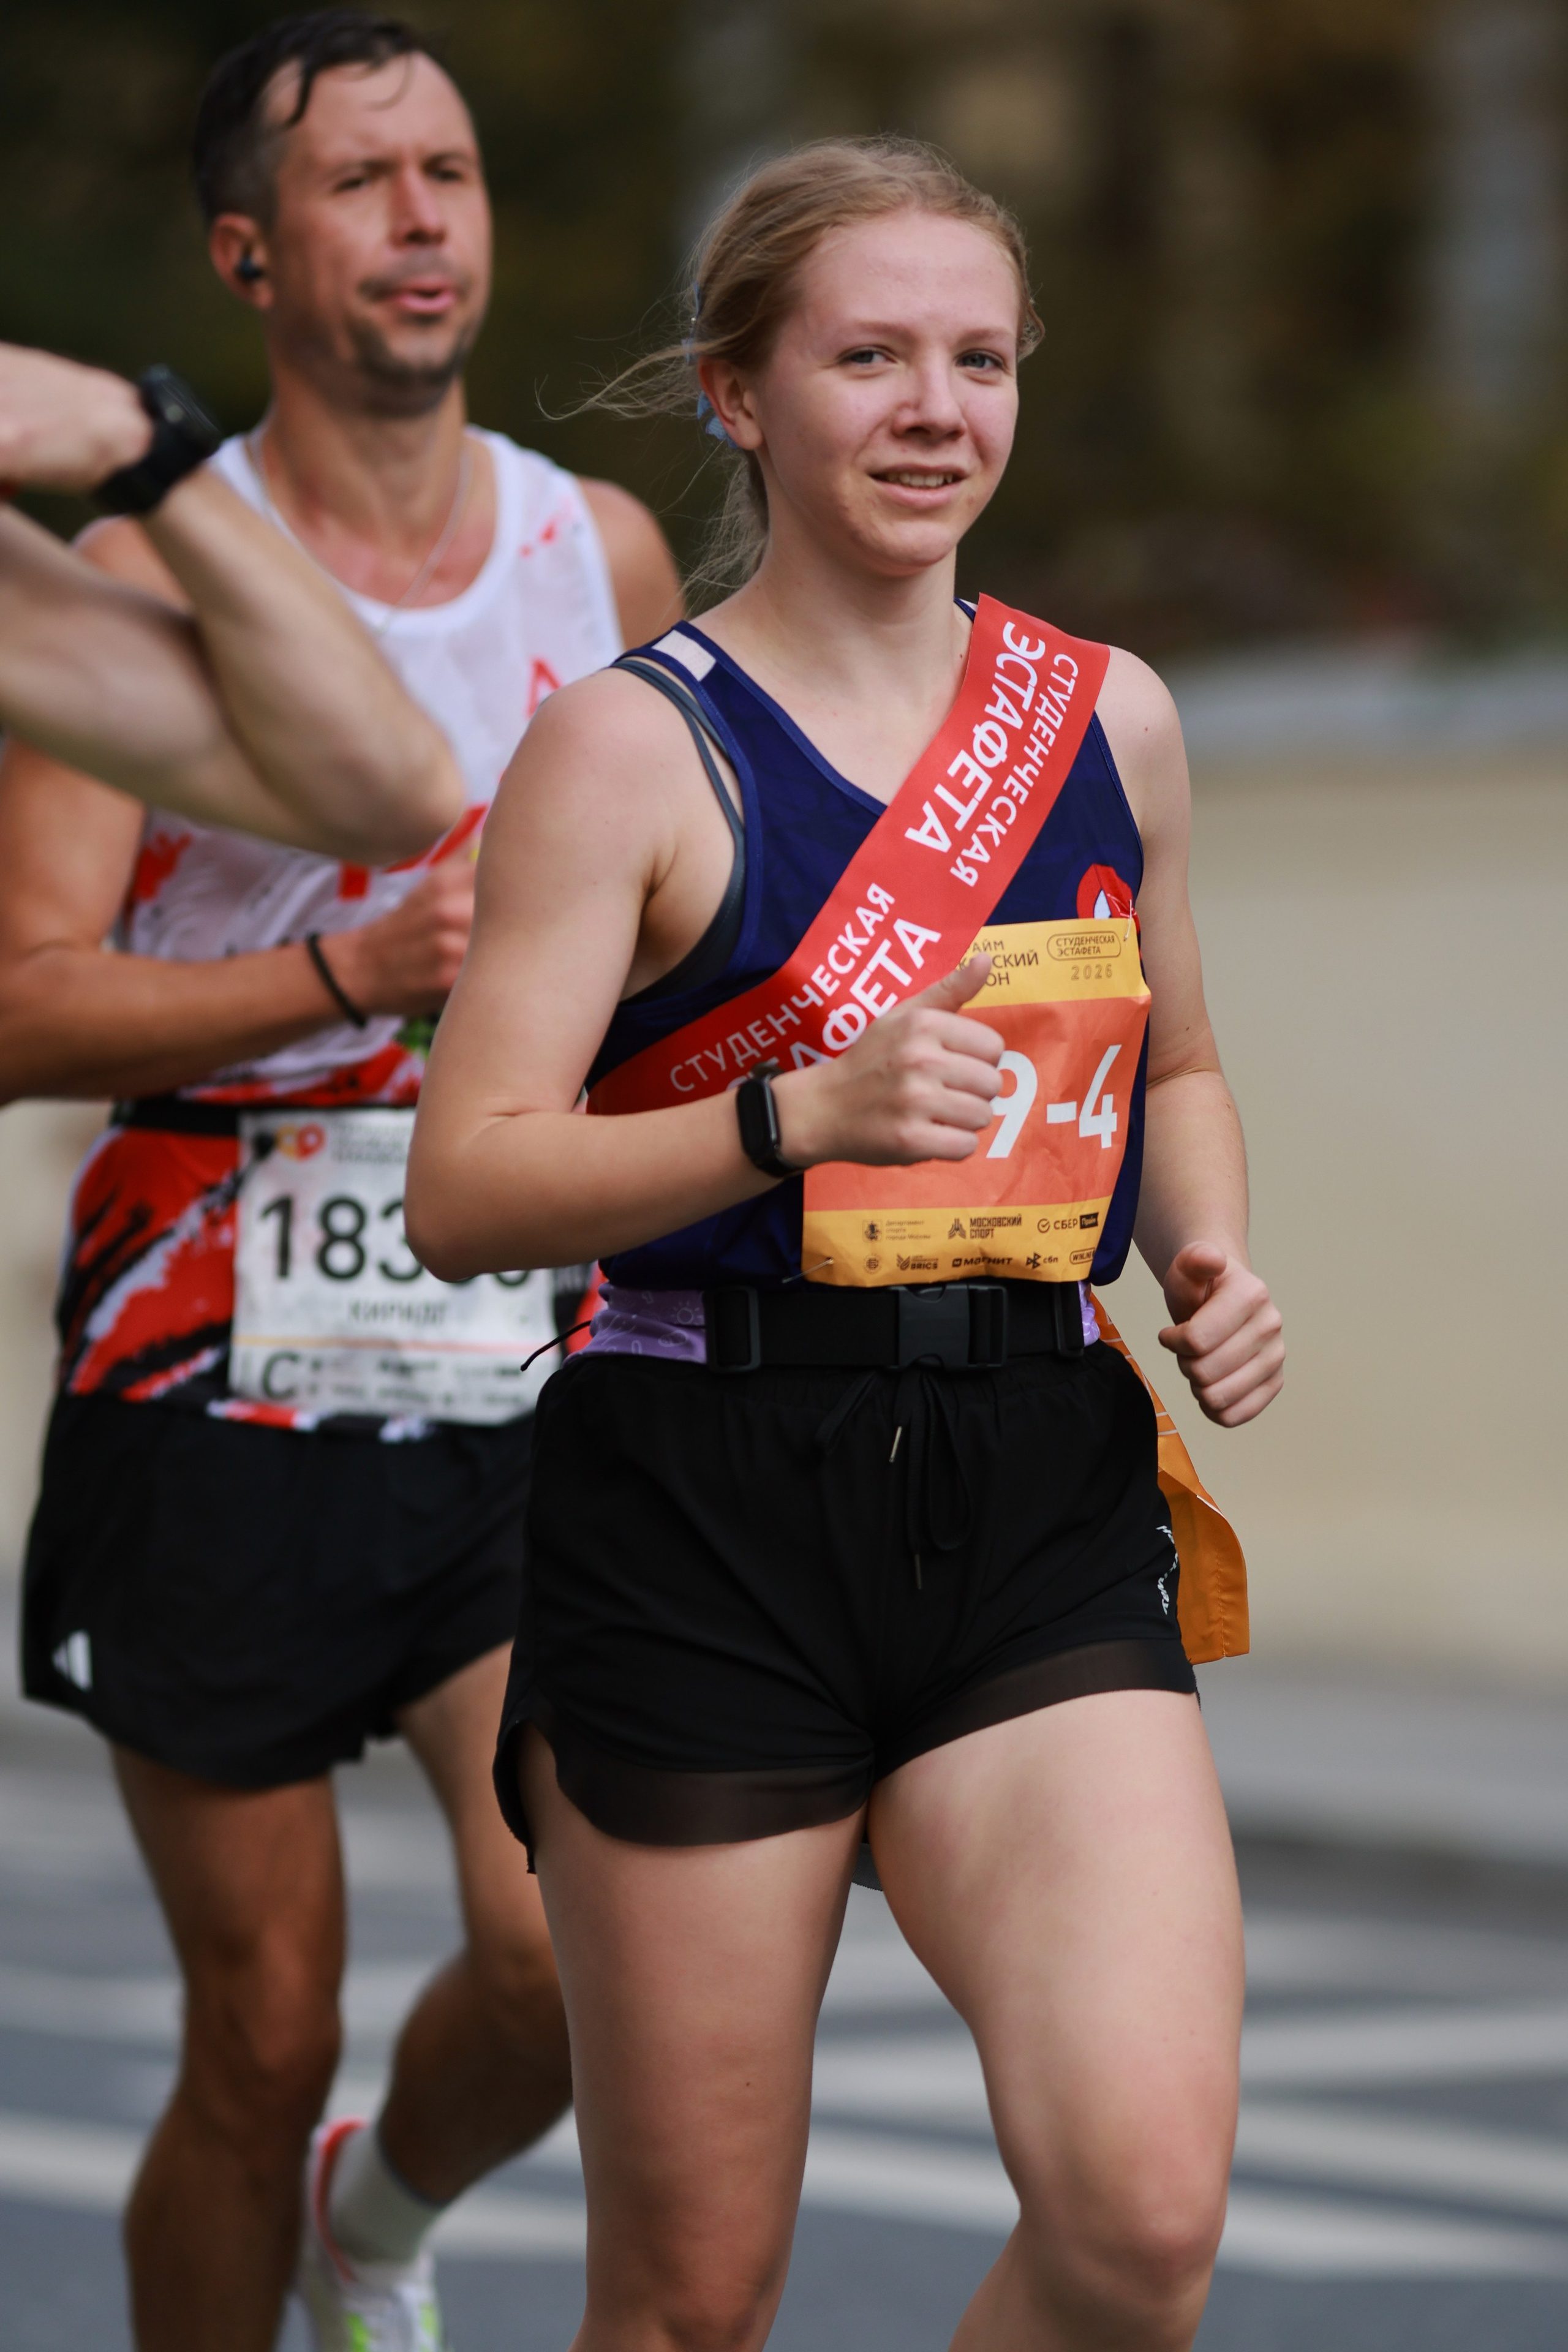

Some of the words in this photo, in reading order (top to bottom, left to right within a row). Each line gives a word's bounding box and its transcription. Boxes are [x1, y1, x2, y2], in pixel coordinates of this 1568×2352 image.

[905, 621, 1046, 853] ЭСТАФЕТА
[950, 654, 1079, 887] СТУДЕНЧЕСКАЯ
[972, 938, 1005, 952] АЙМ
[1055, 935, 1115, 947] СТУДЕНЧЕСКАЯ
[1057, 946, 1101, 957] ЭСТАФЕТА
[1071, 963, 1113, 980] 2026
[669, 883, 895, 1091] СТУДЕНЧЕСКАЯ
[986, 1044, 1122, 1159] 9-4
[970, 1213, 1022, 1227] МОСКОВСКИЙ
[1054, 1218, 1078, 1230] СБЕР
[970, 1229, 994, 1239] СПОРТ
